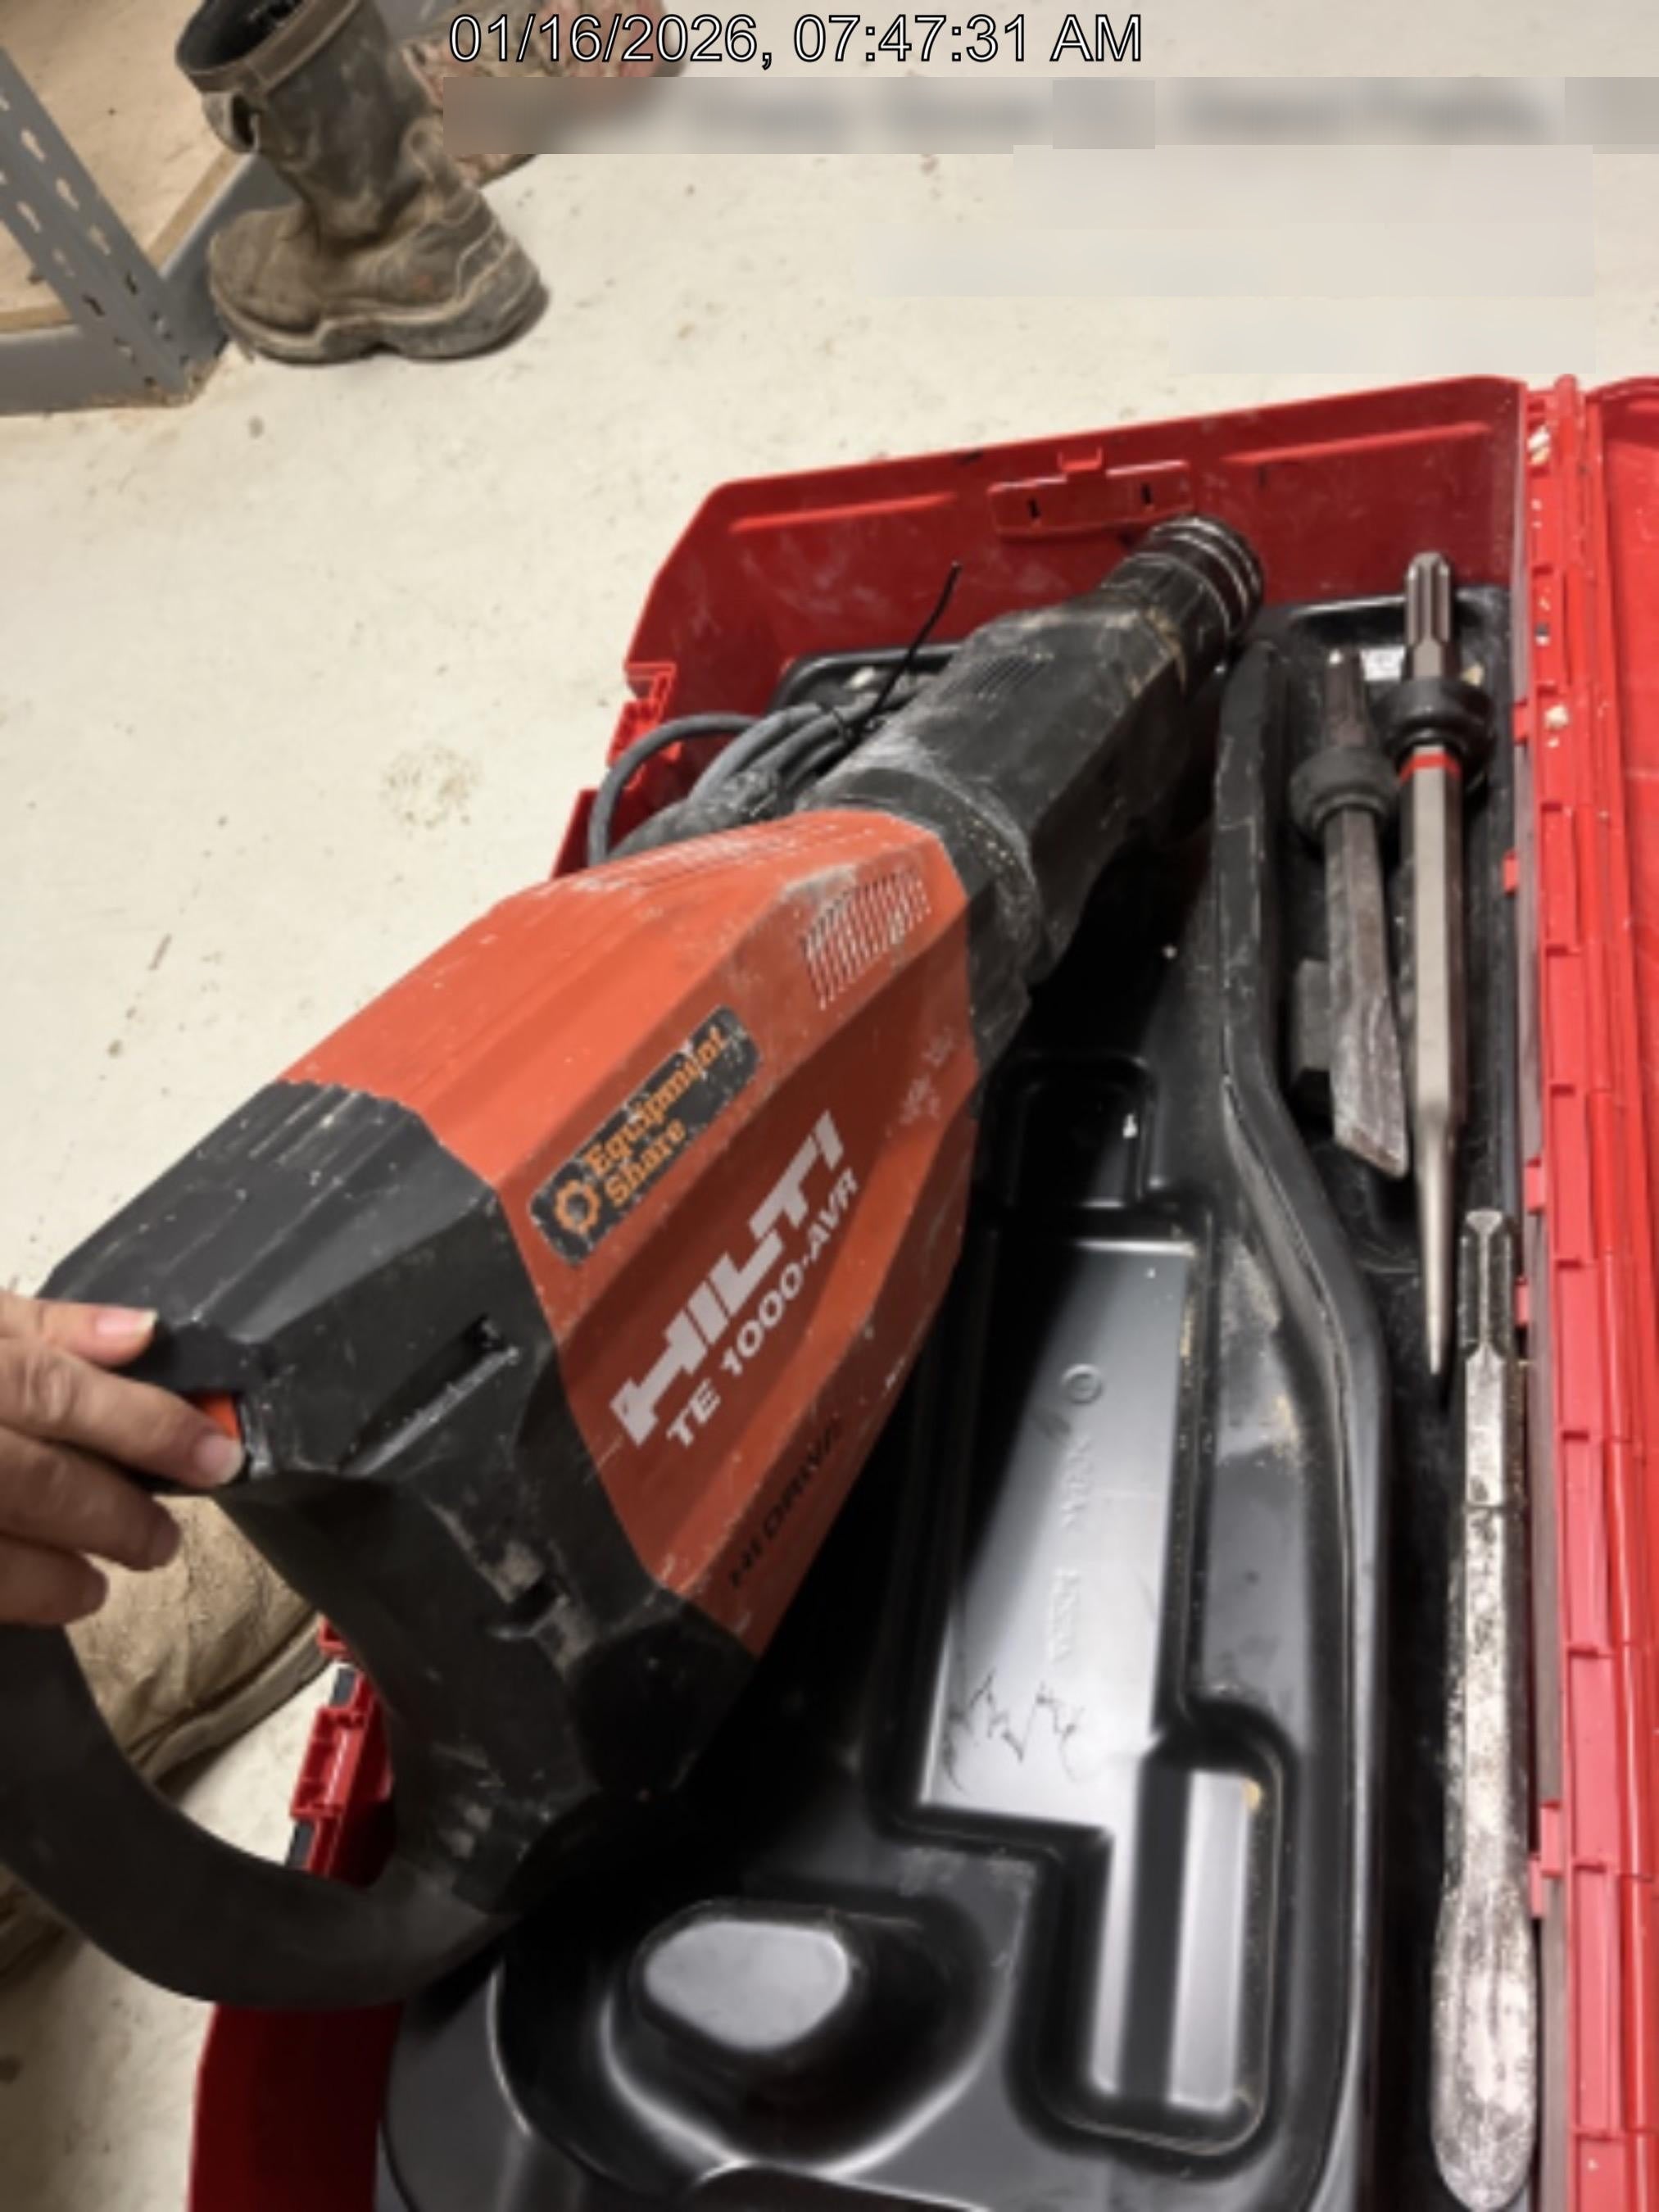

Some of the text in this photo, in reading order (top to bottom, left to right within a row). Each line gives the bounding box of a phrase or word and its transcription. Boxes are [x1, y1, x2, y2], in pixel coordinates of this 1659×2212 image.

[605, 1120, 687, 1208] Share
[610, 1110, 844, 1447] HILTI
[666, 1167, 859, 1448] TE 1000-AVR
